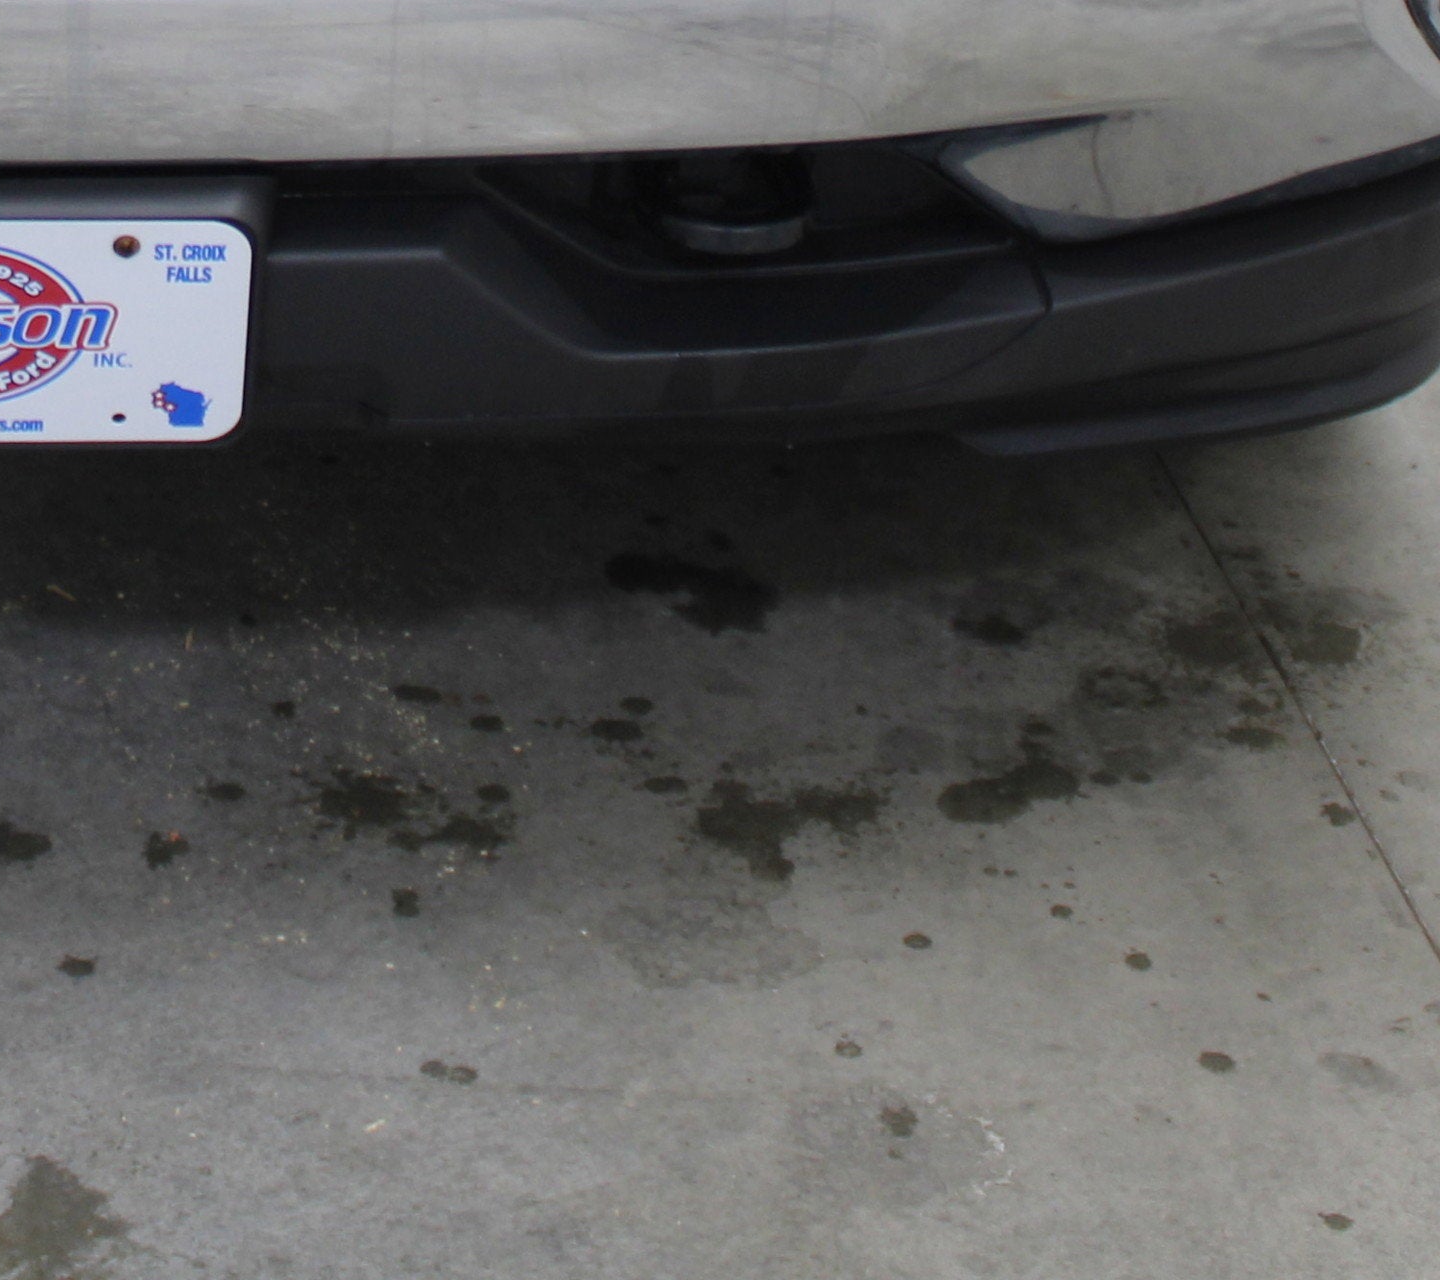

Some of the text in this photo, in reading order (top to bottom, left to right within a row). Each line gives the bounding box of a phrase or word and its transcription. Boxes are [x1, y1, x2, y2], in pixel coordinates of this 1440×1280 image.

[153, 244, 227, 262] ST. CROIX
[166, 266, 213, 283] FALLS
[93, 352, 133, 369] INC.
